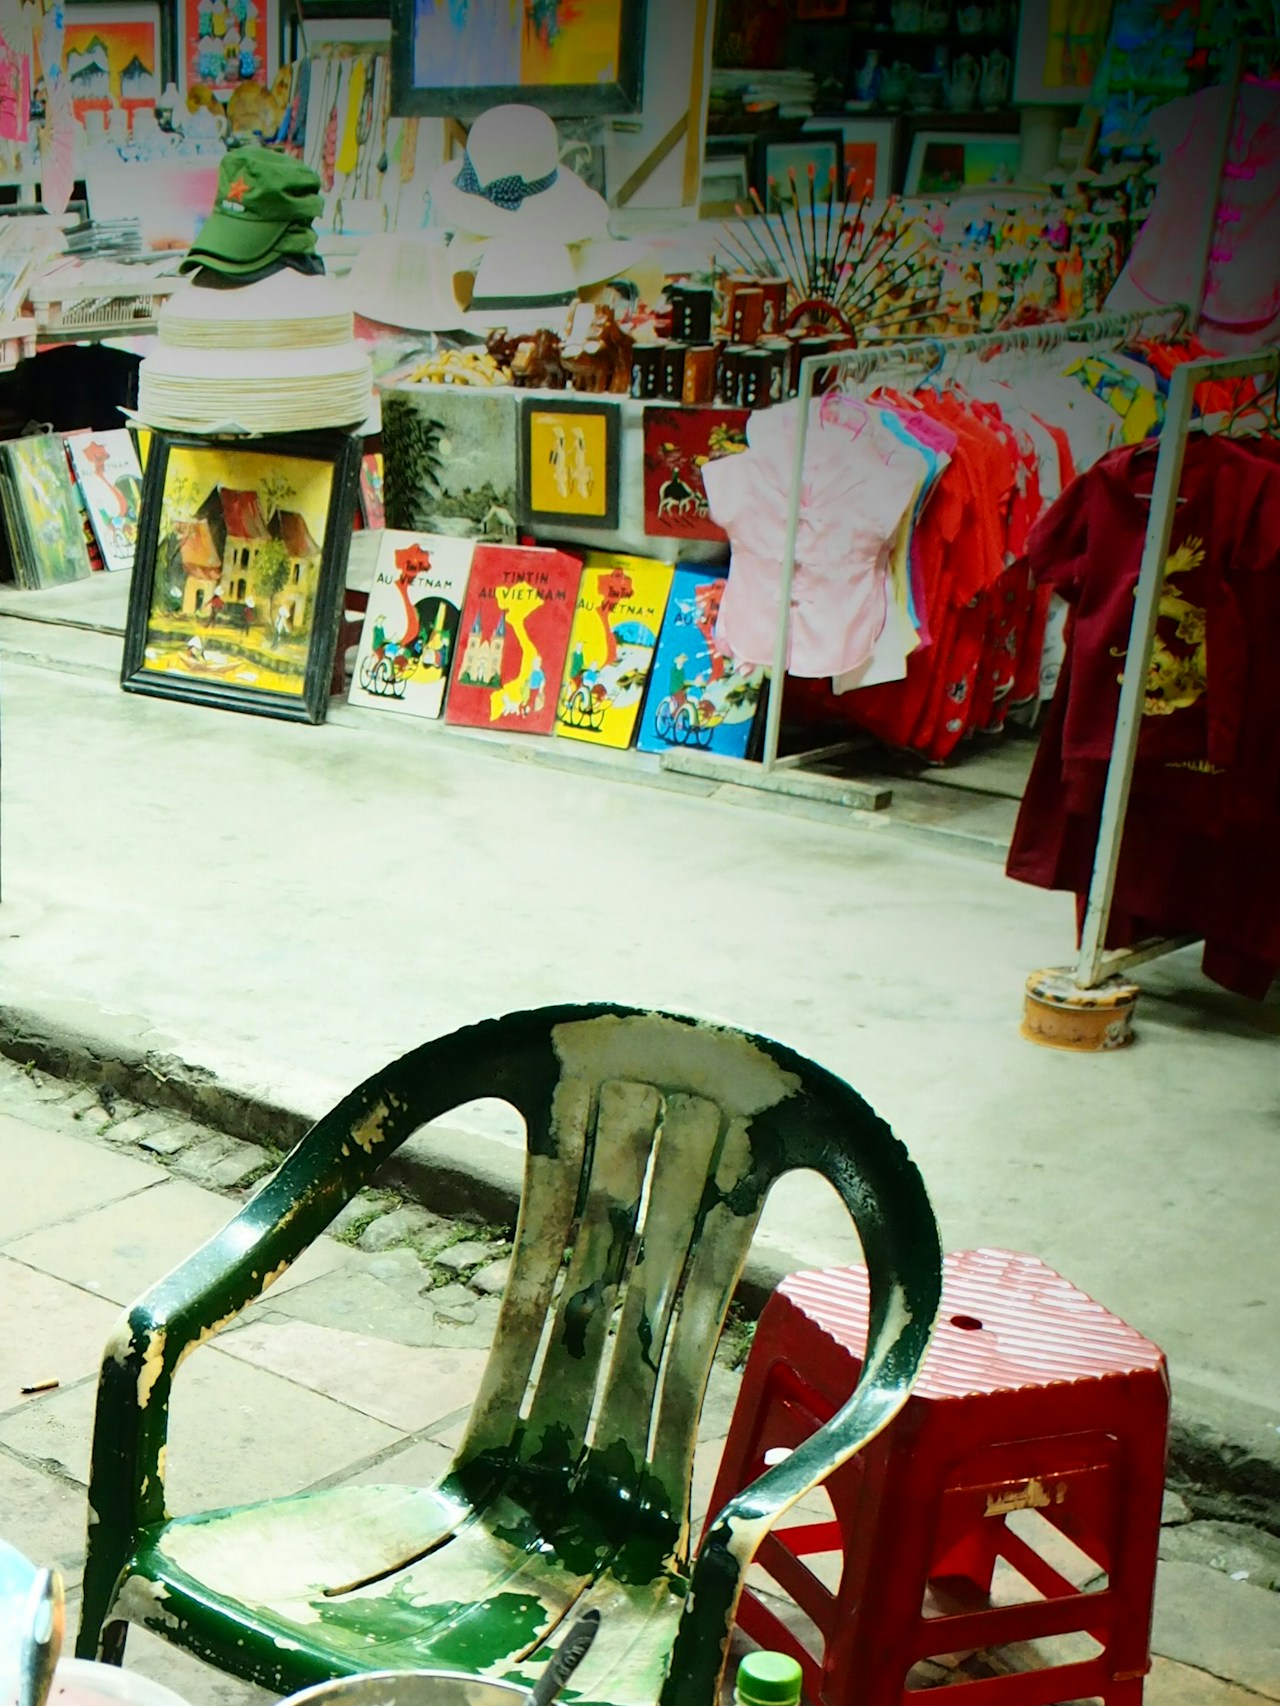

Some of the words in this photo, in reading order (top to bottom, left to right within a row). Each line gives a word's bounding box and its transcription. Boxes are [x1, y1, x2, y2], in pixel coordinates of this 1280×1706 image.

[376, 572, 393, 585] AU
[400, 573, 453, 589] VIETNAM
[503, 571, 549, 585] TINTIN
[479, 586, 496, 599] AU
[502, 588, 566, 602] VIETNAM
[576, 598, 594, 612] AU
[601, 600, 655, 616] VIETNAM
